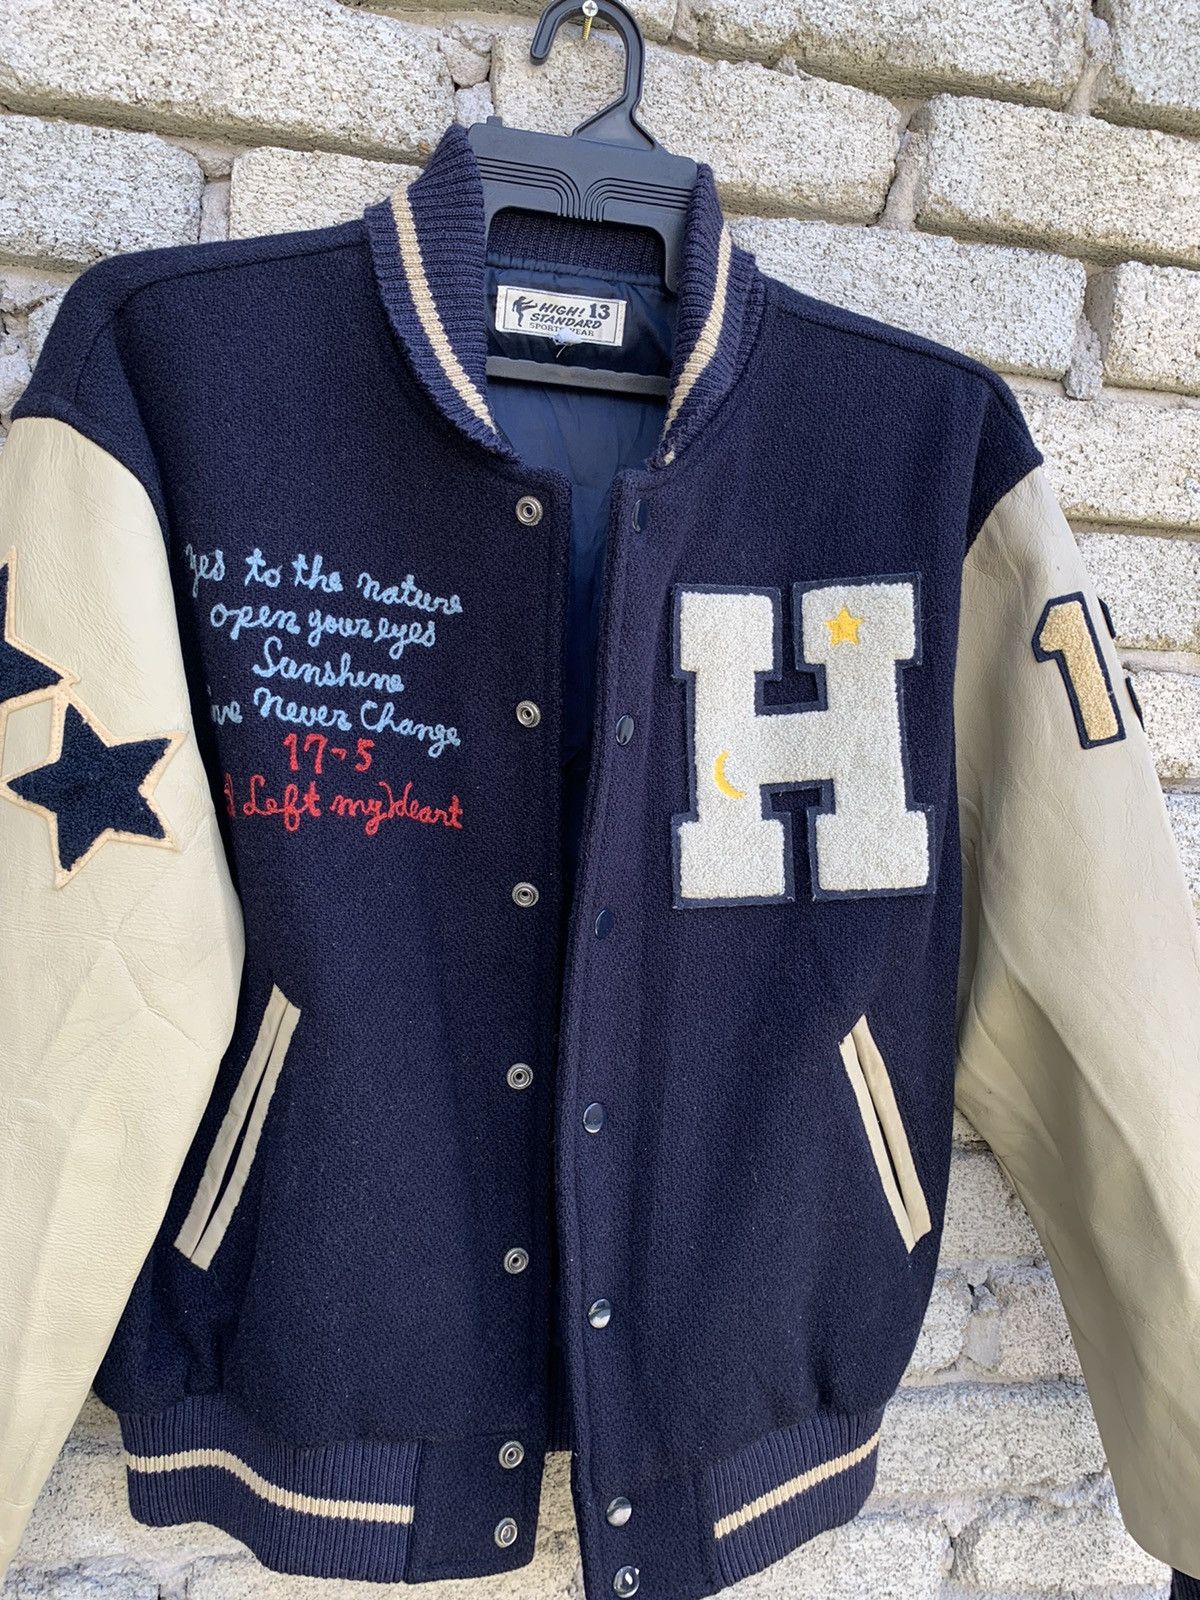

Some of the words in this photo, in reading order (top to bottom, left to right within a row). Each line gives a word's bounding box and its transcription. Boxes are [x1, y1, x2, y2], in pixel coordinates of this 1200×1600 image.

[530, 312, 602, 329] STANDARD
[530, 322, 594, 337] SPORTEAR
[539, 303, 586, 317] HIGH!
[589, 303, 611, 320] 13
[245, 548, 282, 587] to
[292, 554, 343, 593] the
[210, 603, 300, 640] open
[308, 609, 373, 647] your
[374, 617, 436, 660] eyes
[360, 700, 461, 758] Change
[672, 571, 936, 909] H
[283, 733, 375, 775] 17-5
